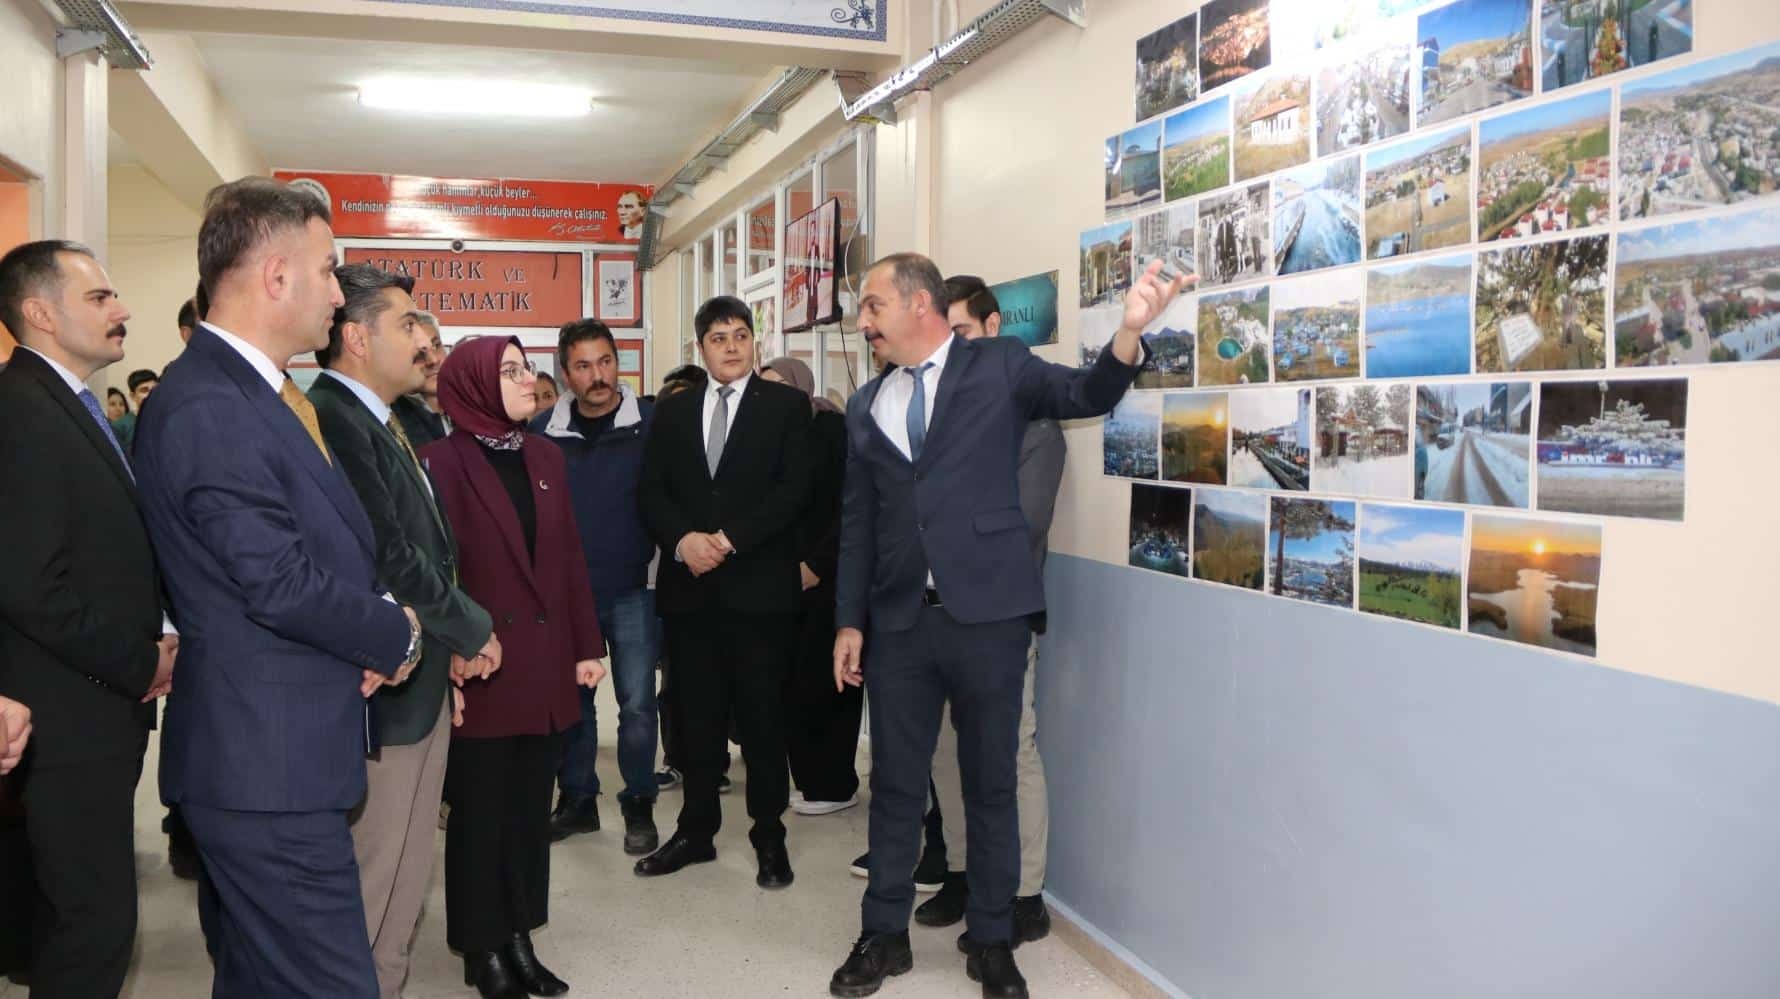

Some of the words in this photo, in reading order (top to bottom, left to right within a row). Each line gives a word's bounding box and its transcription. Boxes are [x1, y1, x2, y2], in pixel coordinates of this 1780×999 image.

[341, 199, 384, 213] Kendinizin
[485, 203, 530, 219] olduğunuzu
[531, 206, 573, 220] düşünerek
[366, 257, 485, 281] TATÜRK
[503, 268, 527, 283] VE
